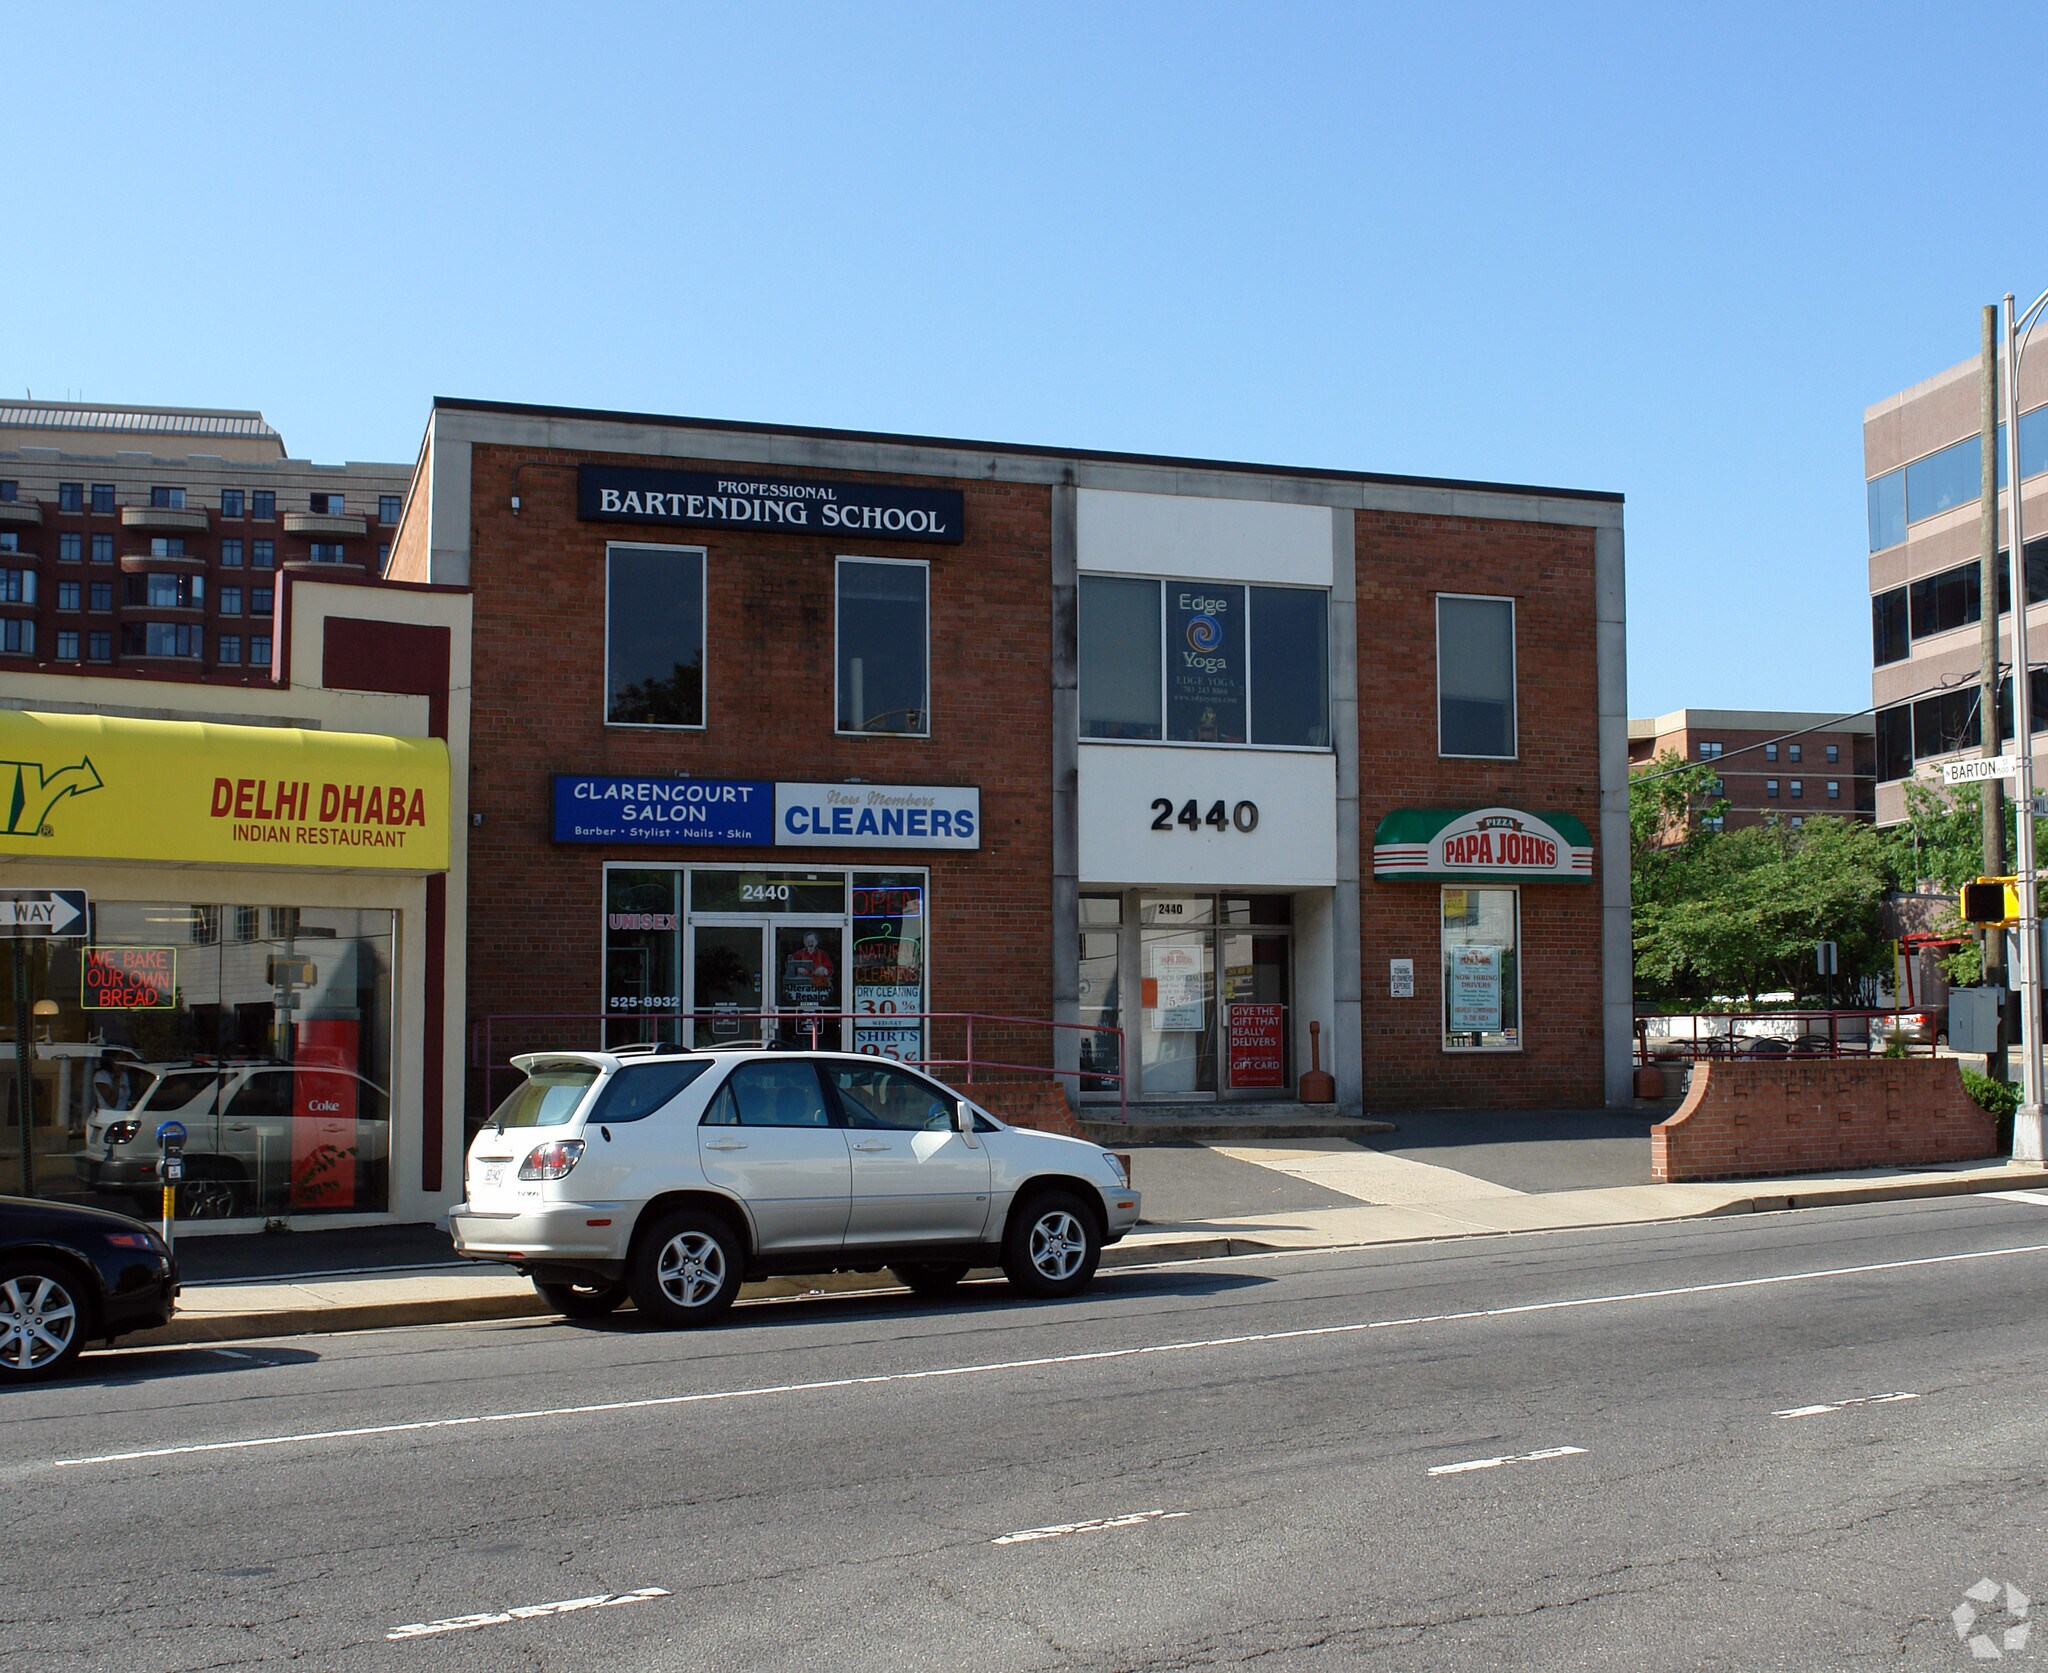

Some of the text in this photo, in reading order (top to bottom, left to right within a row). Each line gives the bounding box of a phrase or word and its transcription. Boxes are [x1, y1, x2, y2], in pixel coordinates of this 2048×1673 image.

[717, 480, 838, 500] PROFESSIONAL
[600, 488, 946, 534] BARTENDING SCHOOL
[1179, 593, 1228, 616] Edge
[1182, 651, 1227, 674] Yoga
[1207, 677, 1236, 687] YOGA
[1951, 761, 1996, 780] BARTON
[573, 782, 754, 803] CLARENCOURT
[826, 789, 936, 807] New Members
[210, 777, 426, 827] DELHI DHABA
[2033, 798, 2048, 814] WIL
[621, 804, 707, 822] SALON
[784, 805, 975, 838] CLEANERS
[1150, 797, 1259, 833] 2440
[1485, 818, 1514, 827] PIZZA
[232, 824, 407, 848] INDIAN RESTAURANT
[574, 826, 752, 840] Barber Stylist Nails Skin
[1445, 833, 1555, 865] PAPA JOHN'S
[742, 884, 790, 900] 2440
[853, 890, 919, 915] OPEN
[1158, 903, 1183, 915] 2440
[14, 904, 56, 922] WAY
[608, 913, 679, 930] UNISEX
[87, 951, 168, 969] WE BAKE
[87, 969, 170, 989] OUR OWN
[784, 983, 834, 993] Alterations
[795, 992, 829, 1001] Repairs
[857, 986, 919, 998] DRY CLEANING
[100, 988, 158, 1007] BREAD
[610, 996, 680, 1008] 525-8932
[901, 1001, 916, 1011] %
[1232, 1006, 1275, 1016] GIVE THE
[1232, 1016, 1280, 1026] GIFT THAT
[857, 1031, 919, 1042] SHIRTS
[1232, 1027, 1266, 1036] REALLY
[1232, 1037, 1277, 1047] DELIVERS
[1233, 1061, 1280, 1070] GIFT CARD
[308, 1099, 340, 1111] Coke
